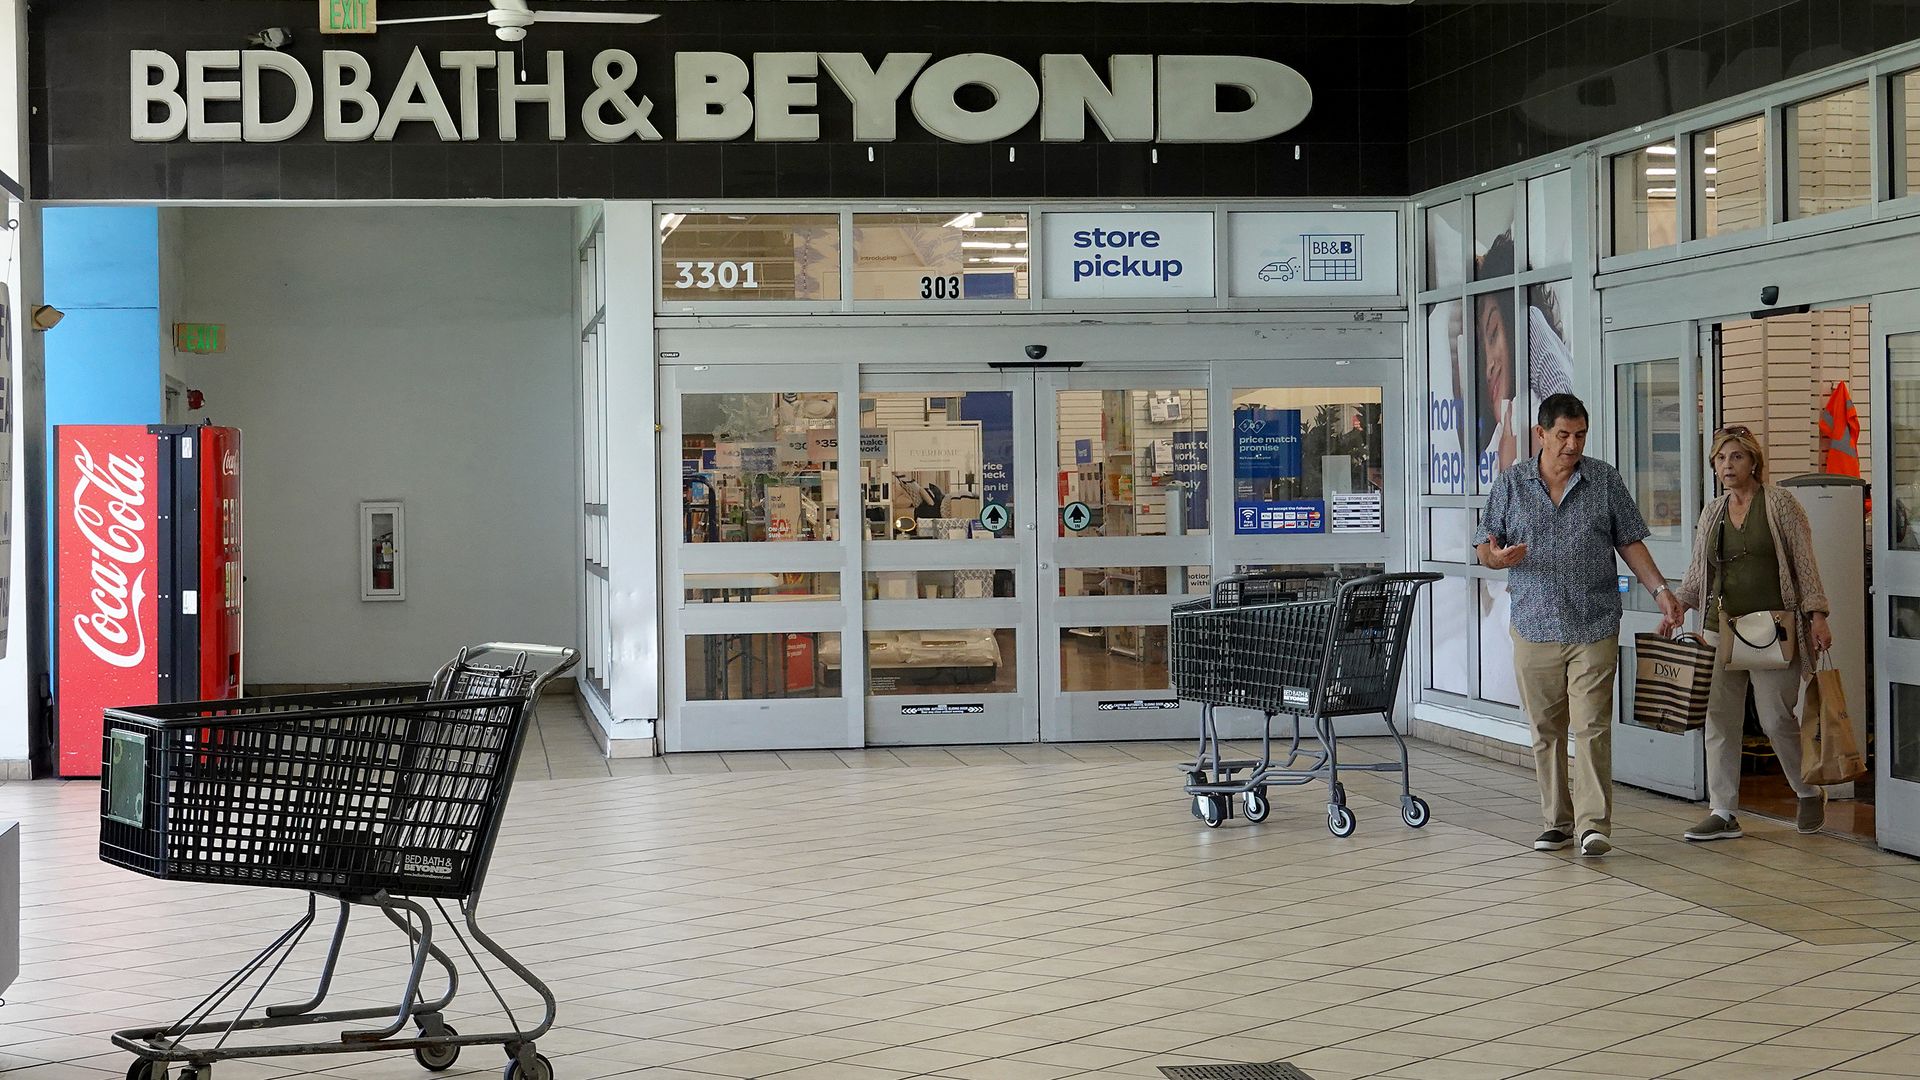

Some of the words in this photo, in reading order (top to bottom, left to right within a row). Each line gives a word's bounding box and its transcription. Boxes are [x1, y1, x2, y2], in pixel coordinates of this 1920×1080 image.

[330, 0, 368, 29] EXIT
[130, 49, 314, 143] BED
[322, 46, 567, 143] BATH
[580, 48, 663, 143] &
[675, 51, 1313, 144] BEYOND
[1073, 228, 1161, 249] store
[1313, 241, 1353, 255] BB&B
[674, 261, 759, 289] 3301
[1073, 254, 1183, 282] pickup
[921, 276, 960, 299] 303
[187, 325, 222, 351] EXIT
[1174, 441, 1197, 450] want
[1239, 436, 1264, 445] price
[1265, 435, 1297, 443] match
[1239, 443, 1280, 453] promise
[983, 462, 1003, 470] rice
[1174, 462, 1208, 473] happie
[74, 440, 147, 668] Coca-Cola
[1654, 663, 1681, 678] DSW
[404, 864, 452, 873] BEYOND
[405, 855, 421, 864] BED
[423, 856, 444, 866] BATH
[445, 858, 453, 869] &
